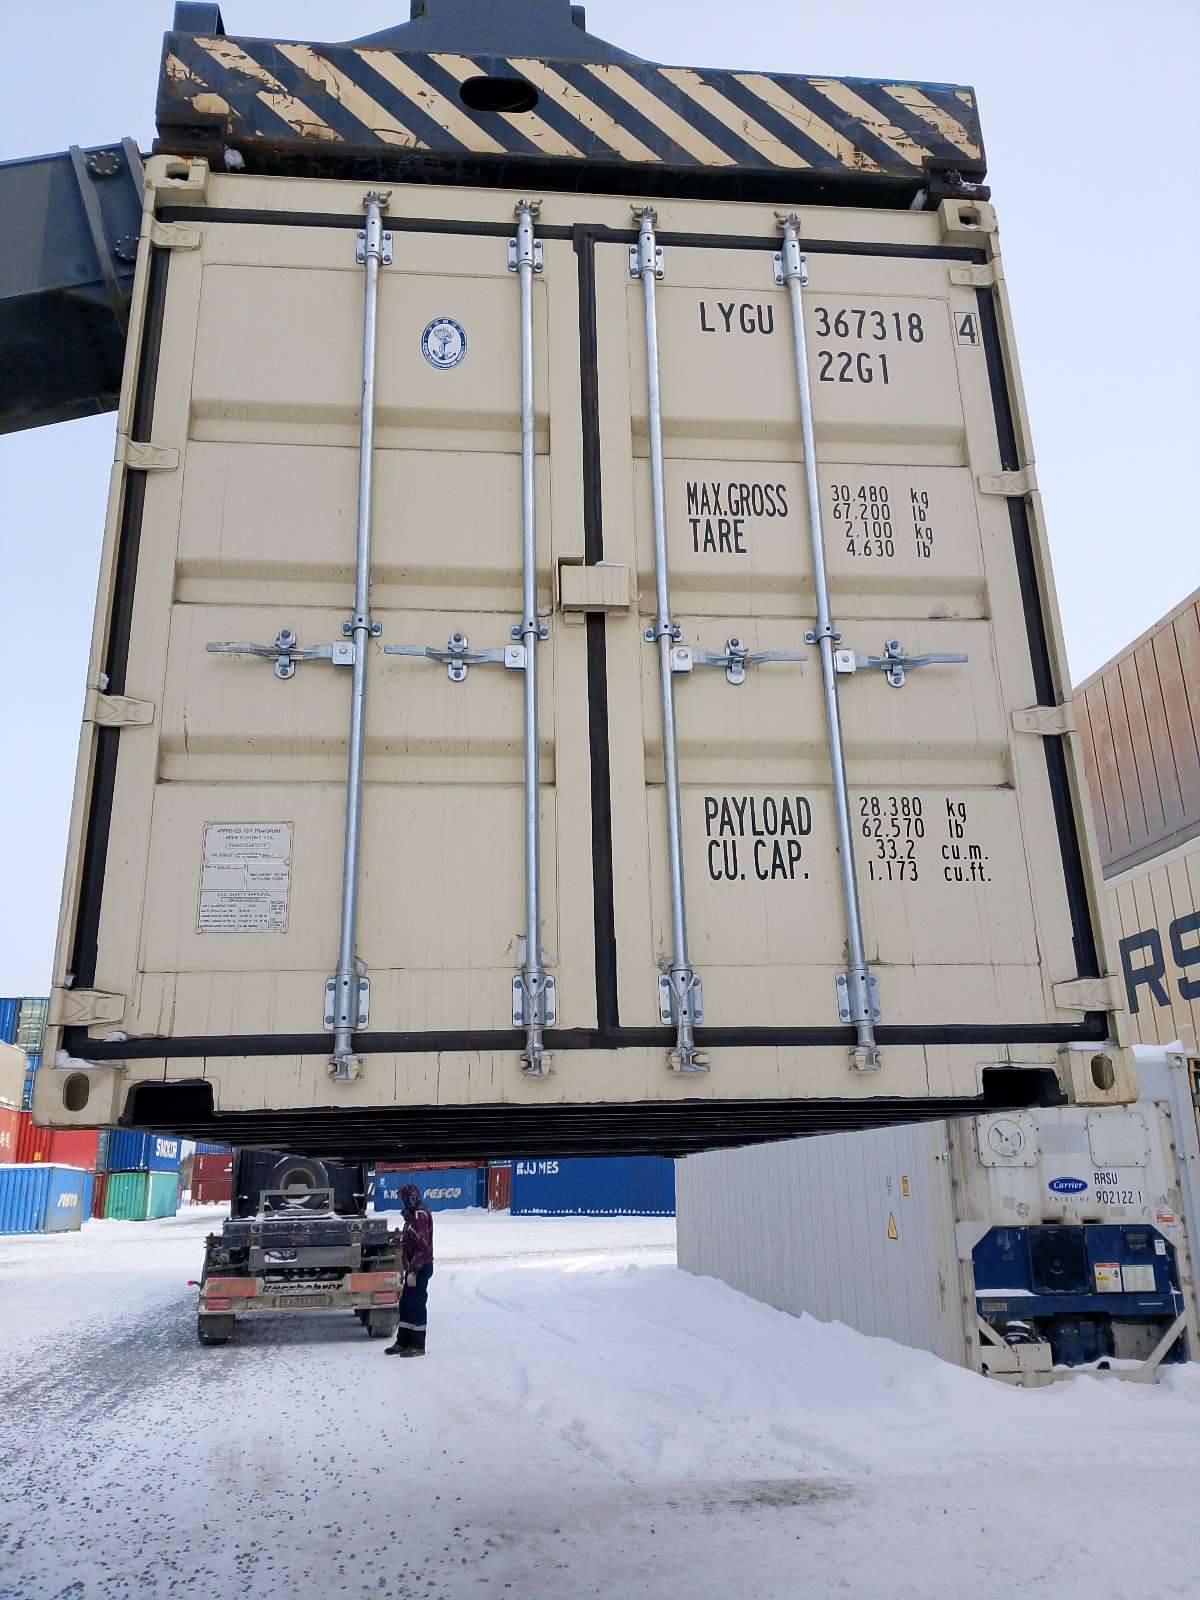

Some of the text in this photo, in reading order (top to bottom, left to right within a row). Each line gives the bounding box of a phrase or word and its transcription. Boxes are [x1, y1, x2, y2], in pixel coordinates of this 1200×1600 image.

[699, 301, 976, 344] LYGU 367318 4
[817, 350, 889, 385] 22G1
[686, 481, 789, 518] MAX.GROSS
[830, 484, 929, 508] 30.480 kg
[832, 502, 927, 522] 67.200 lb
[688, 518, 748, 554] TARE
[844, 520, 934, 544] 2.100 kg
[846, 538, 932, 558] 4.630 lb
[703, 796, 812, 837] PAYLOAD
[858, 796, 967, 823] 28.380 kg
[861, 817, 965, 839] 62.570 lb
[707, 839, 810, 881] CU. CAP.
[876, 839, 990, 860] 33.2 cu.m.
[867, 860, 993, 882] 1.173 cu.ft.
[1053, 1180, 1084, 1190] Carrier
[1093, 1172, 1118, 1185] RRSU
[1095, 1190, 1135, 1204] 902122
